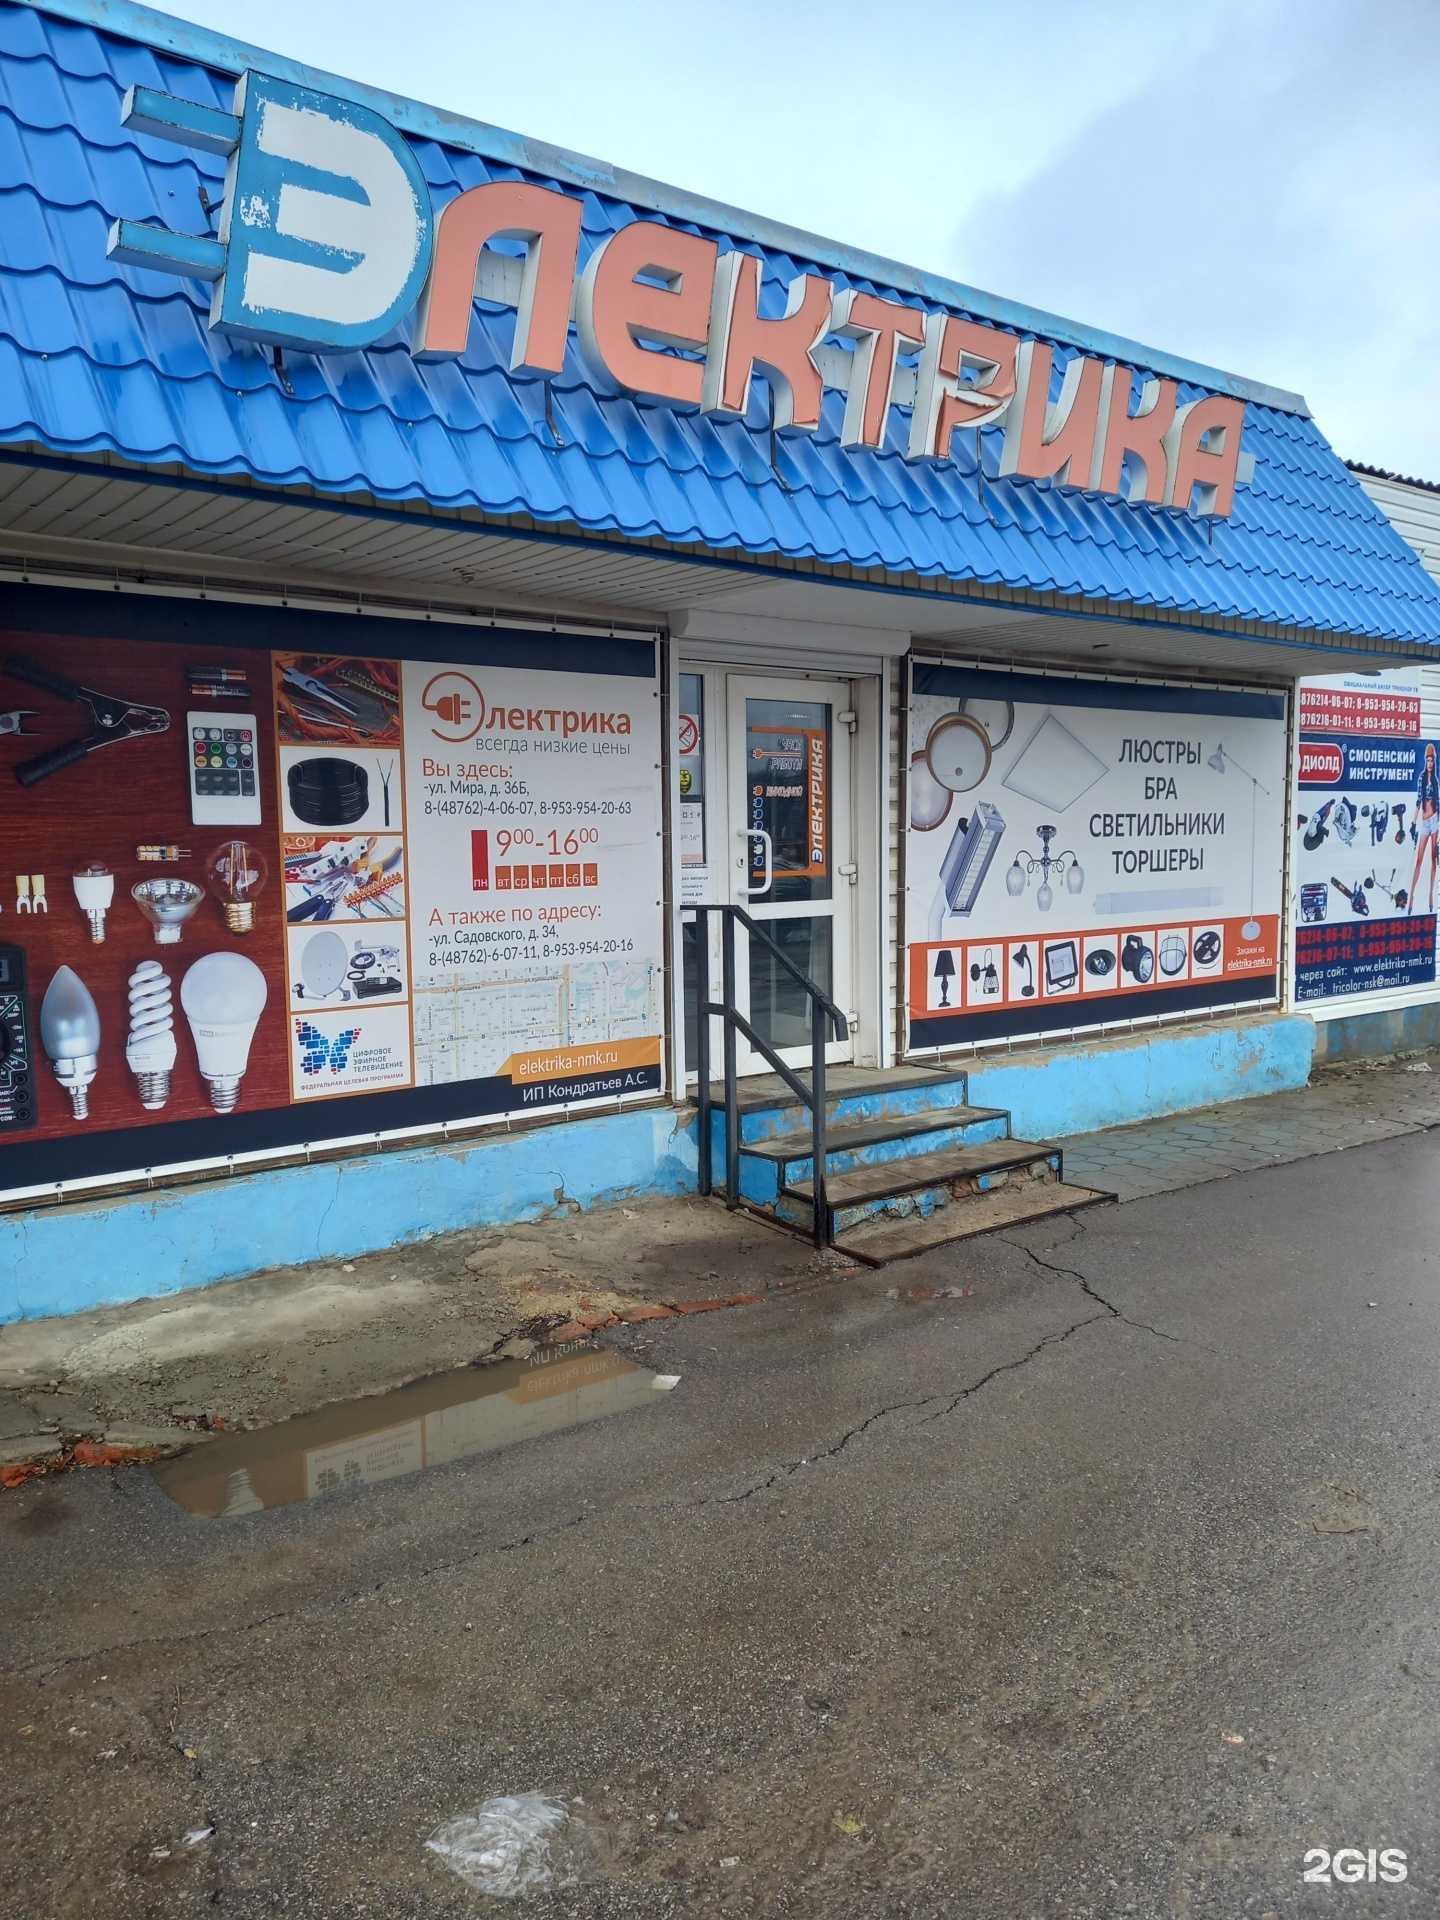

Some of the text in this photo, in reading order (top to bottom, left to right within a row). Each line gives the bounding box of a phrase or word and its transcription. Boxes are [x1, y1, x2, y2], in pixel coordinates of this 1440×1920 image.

[476, 737, 631, 756] всегда низкие цены
[1118, 739, 1201, 764] ЛЮСТРЫ
[1349, 749, 1416, 764] СМОЛЕНСКИЙ
[422, 759, 513, 781] Вы здесь:
[1302, 754, 1341, 774] ДИОЛД
[1349, 767, 1415, 781] ИНСТРУМЕНТ
[450, 781, 486, 796] Мира,
[490, 784, 501, 798] д.
[504, 781, 530, 796] 36Б,
[1144, 777, 1178, 800] БРА
[540, 801, 632, 815] 8-953-954-20-63
[1089, 812, 1225, 837] СВЕТИЛЬНИКИ
[1112, 848, 1204, 874] ТОРШЕРЫ
[567, 873, 580, 884] сб
[429, 903, 601, 926] А также по адресу:
[454, 928, 526, 946] Садовского,
[528, 927, 540, 942] д.
[542, 925, 559, 940] 34,
[543, 938, 634, 958] 8-953-954-20-16
[1300, 970, 1324, 984] через
[1327, 966, 1348, 979] сайт:
[353, 1048, 392, 1058] ЦИФРОВОЕ
[353, 1056, 387, 1065] ЭФИРНОЕ
[519, 1050, 619, 1075] elektrika-nmk.ru
[354, 1061, 404, 1073] ТЕЛЕВИДЕНИЕ
[523, 1071, 649, 1102] ИП Кондратьев А.С.
